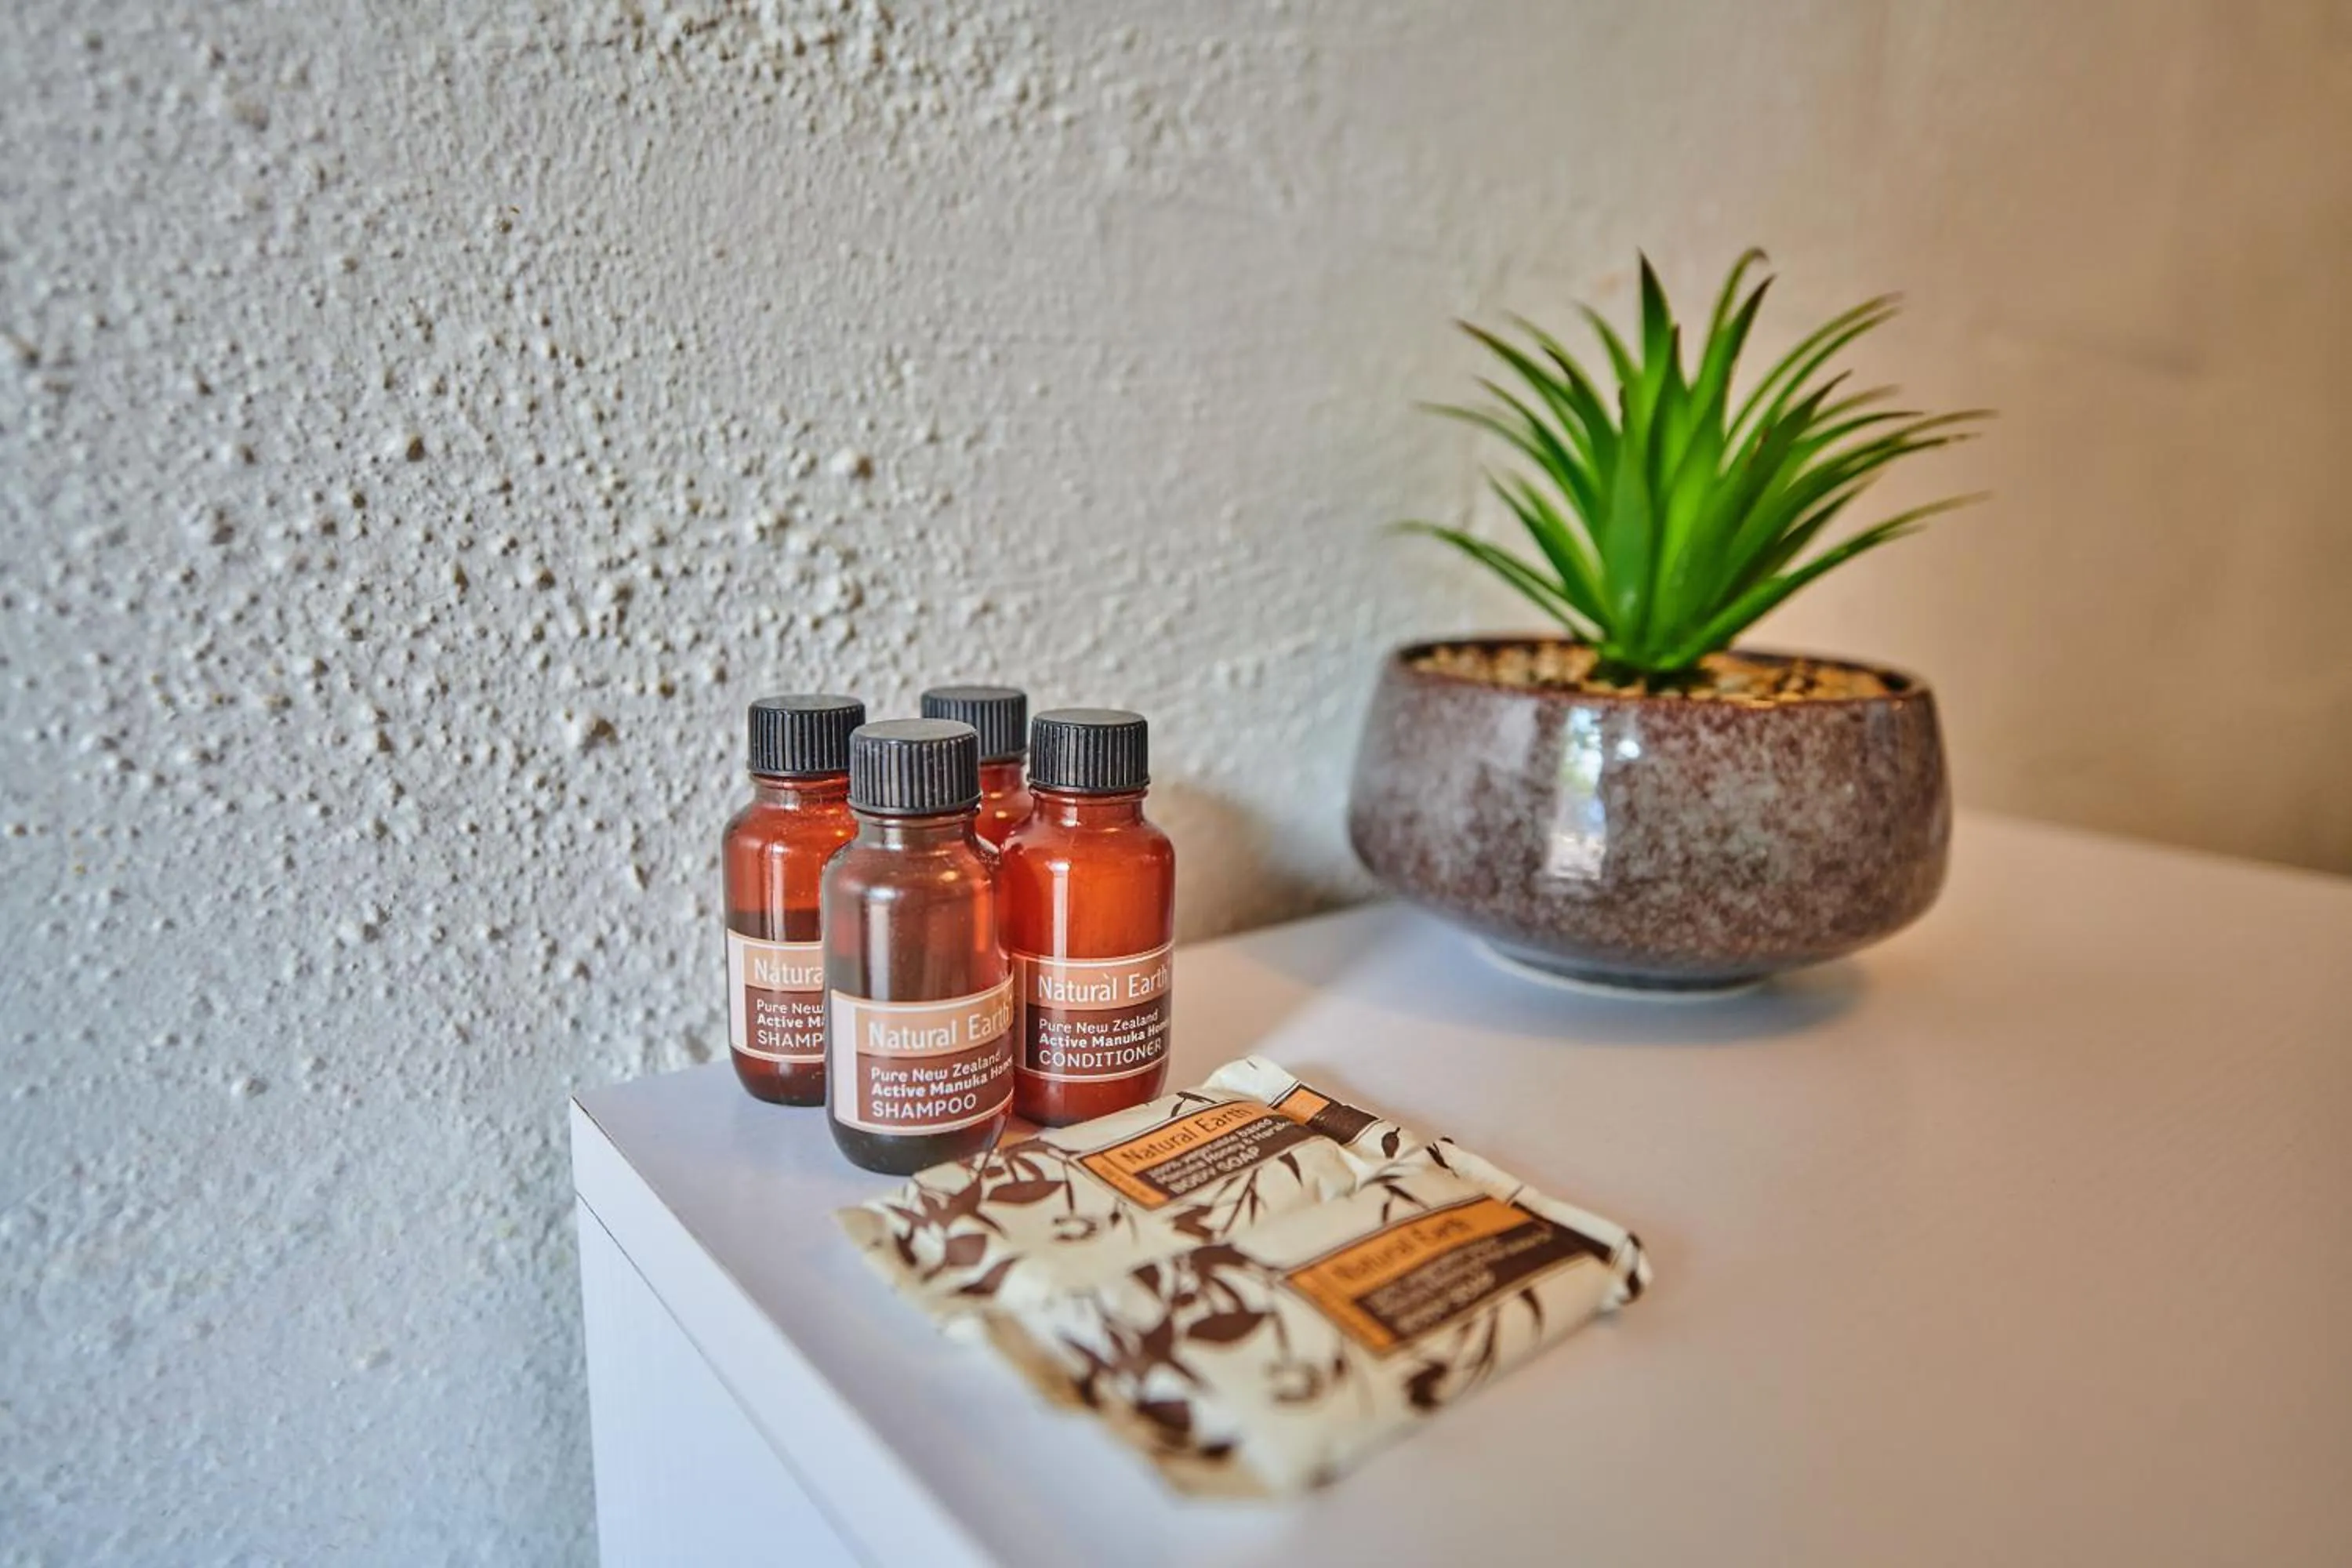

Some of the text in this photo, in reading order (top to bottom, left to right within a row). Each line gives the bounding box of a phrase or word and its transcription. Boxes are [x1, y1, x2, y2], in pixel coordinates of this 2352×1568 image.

[753, 957, 824, 985] Natura
[1128, 964, 1167, 998] Earth
[757, 998, 824, 1014] Pure New
[757, 1013, 804, 1028] Active
[868, 1001, 1010, 1051] Natural Earth
[1039, 1008, 1159, 1035] Pure New Zealand
[757, 1029, 823, 1048] SHAMP
[1039, 1033, 1087, 1048] Active
[1091, 1031, 1145, 1048] Manuka
[1039, 1036, 1162, 1068] CONDITIONER
[871, 1048, 1001, 1082] Pure New Zealand
[871, 1082, 926, 1098] Active
[929, 1073, 988, 1096] Manuka
[872, 1093, 977, 1120] SHAMPOO
[1121, 1106, 1254, 1164] Natural Earth
[1215, 1145, 1261, 1172] SOAP
